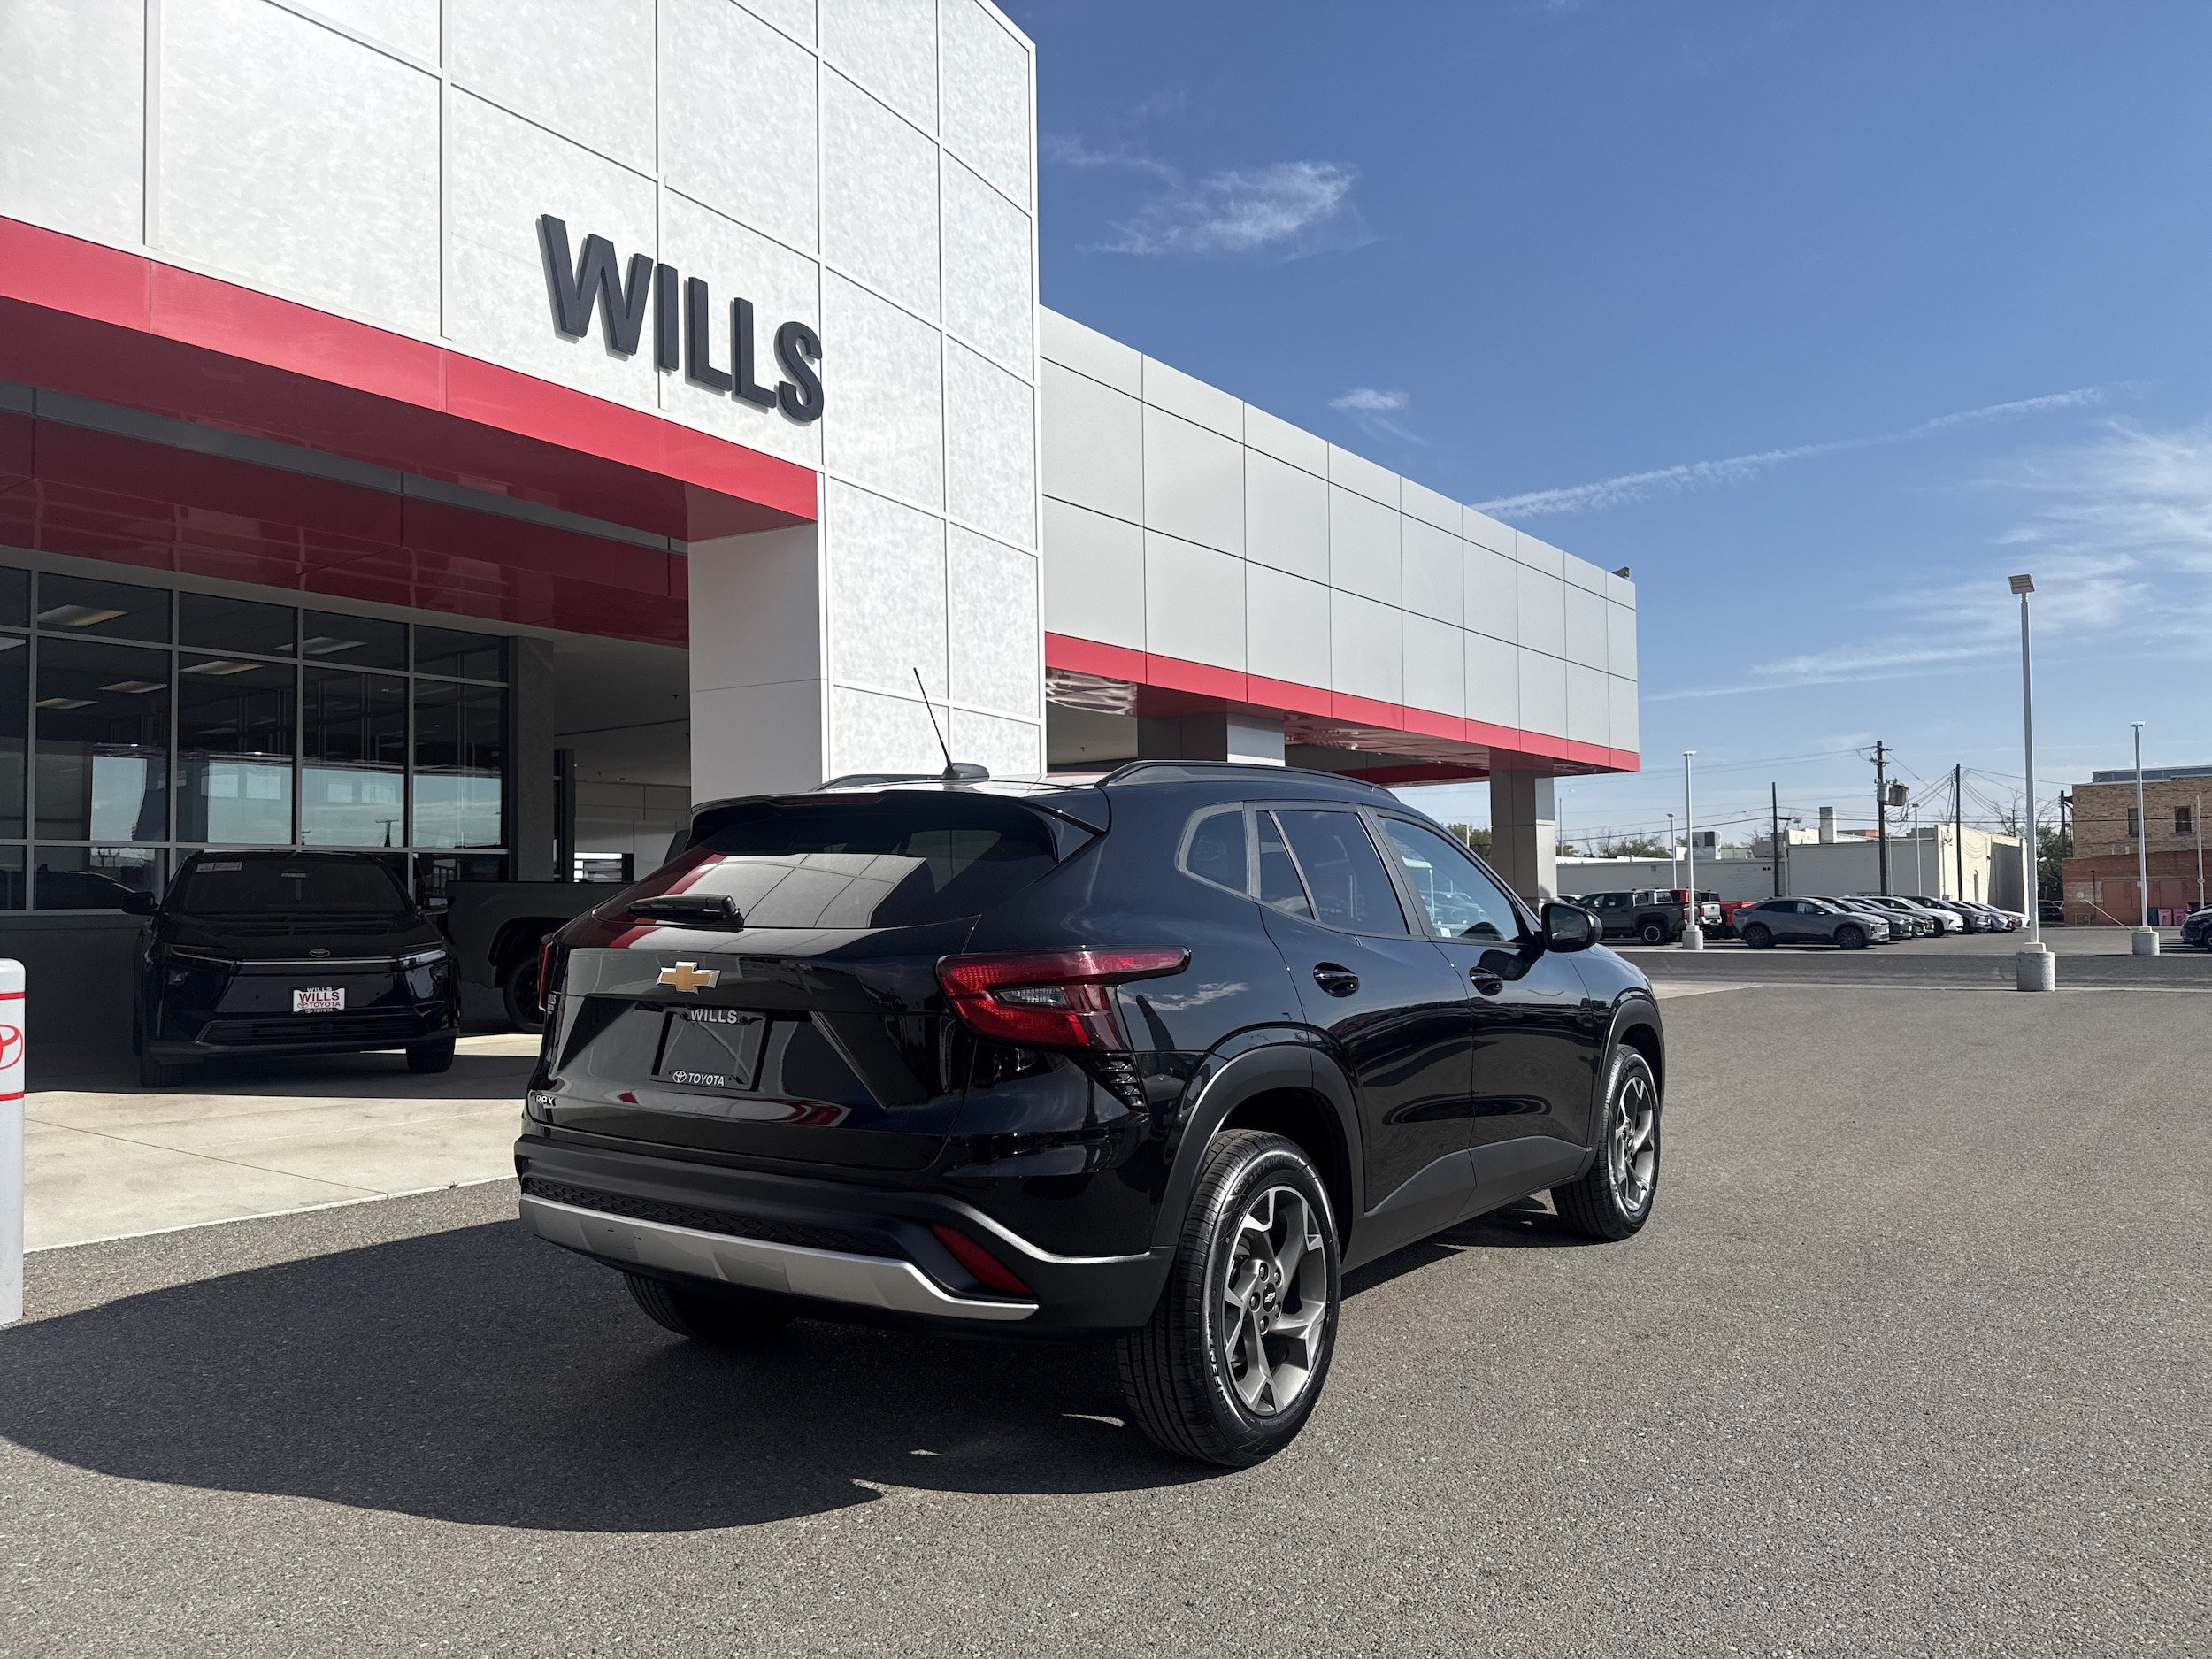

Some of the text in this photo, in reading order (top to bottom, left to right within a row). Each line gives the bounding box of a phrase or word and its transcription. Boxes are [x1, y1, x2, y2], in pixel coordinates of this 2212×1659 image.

[536, 213, 825, 425] WILLS
[299, 991, 340, 1002] WILLS
[691, 1009, 737, 1024] WILLS
[688, 1072, 725, 1086] TOYOTA
